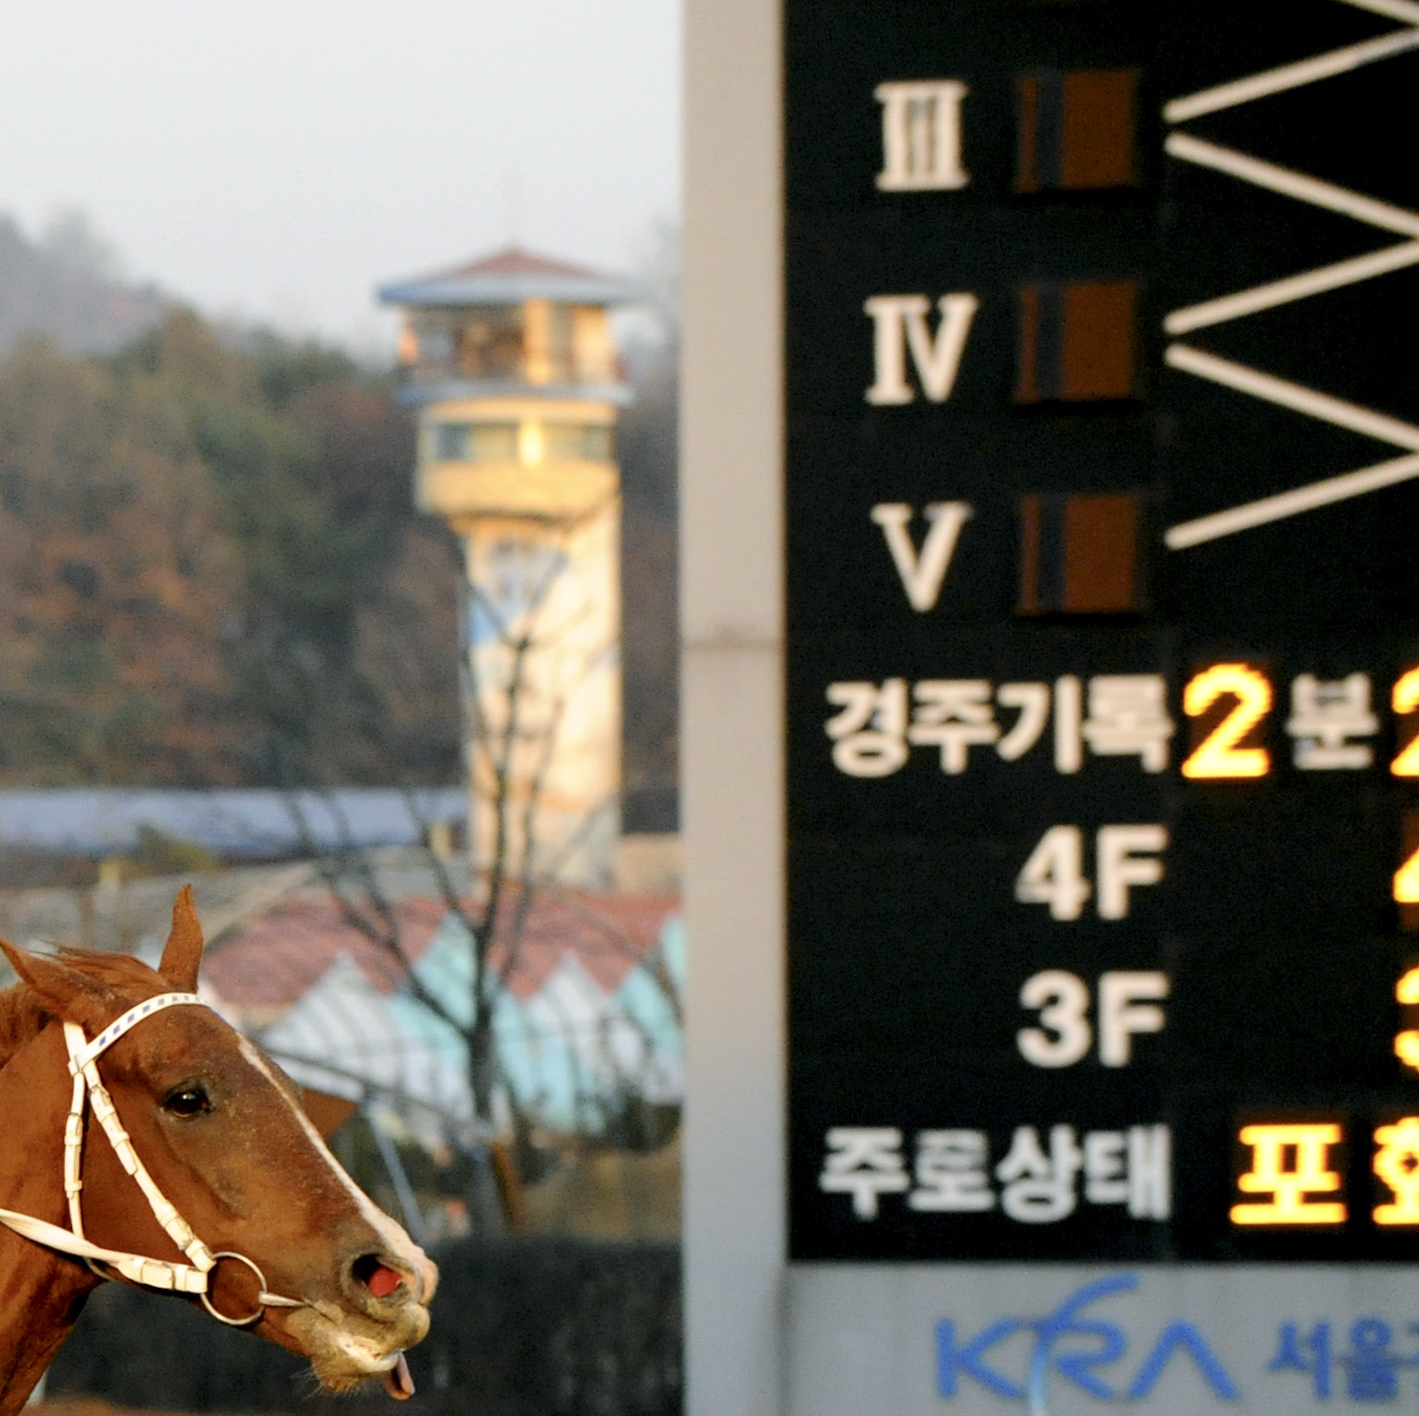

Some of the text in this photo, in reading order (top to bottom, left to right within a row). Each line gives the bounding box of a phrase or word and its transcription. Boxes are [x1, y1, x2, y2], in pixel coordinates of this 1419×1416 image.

[871, 502, 971, 611] V
[825, 675, 1174, 778] 경주기록
[1016, 825, 1169, 921] 4F
[1017, 970, 1169, 1068] 3F
[820, 1124, 1172, 1222] 주로상태
[934, 1272, 1419, 1403] KRA 서울
